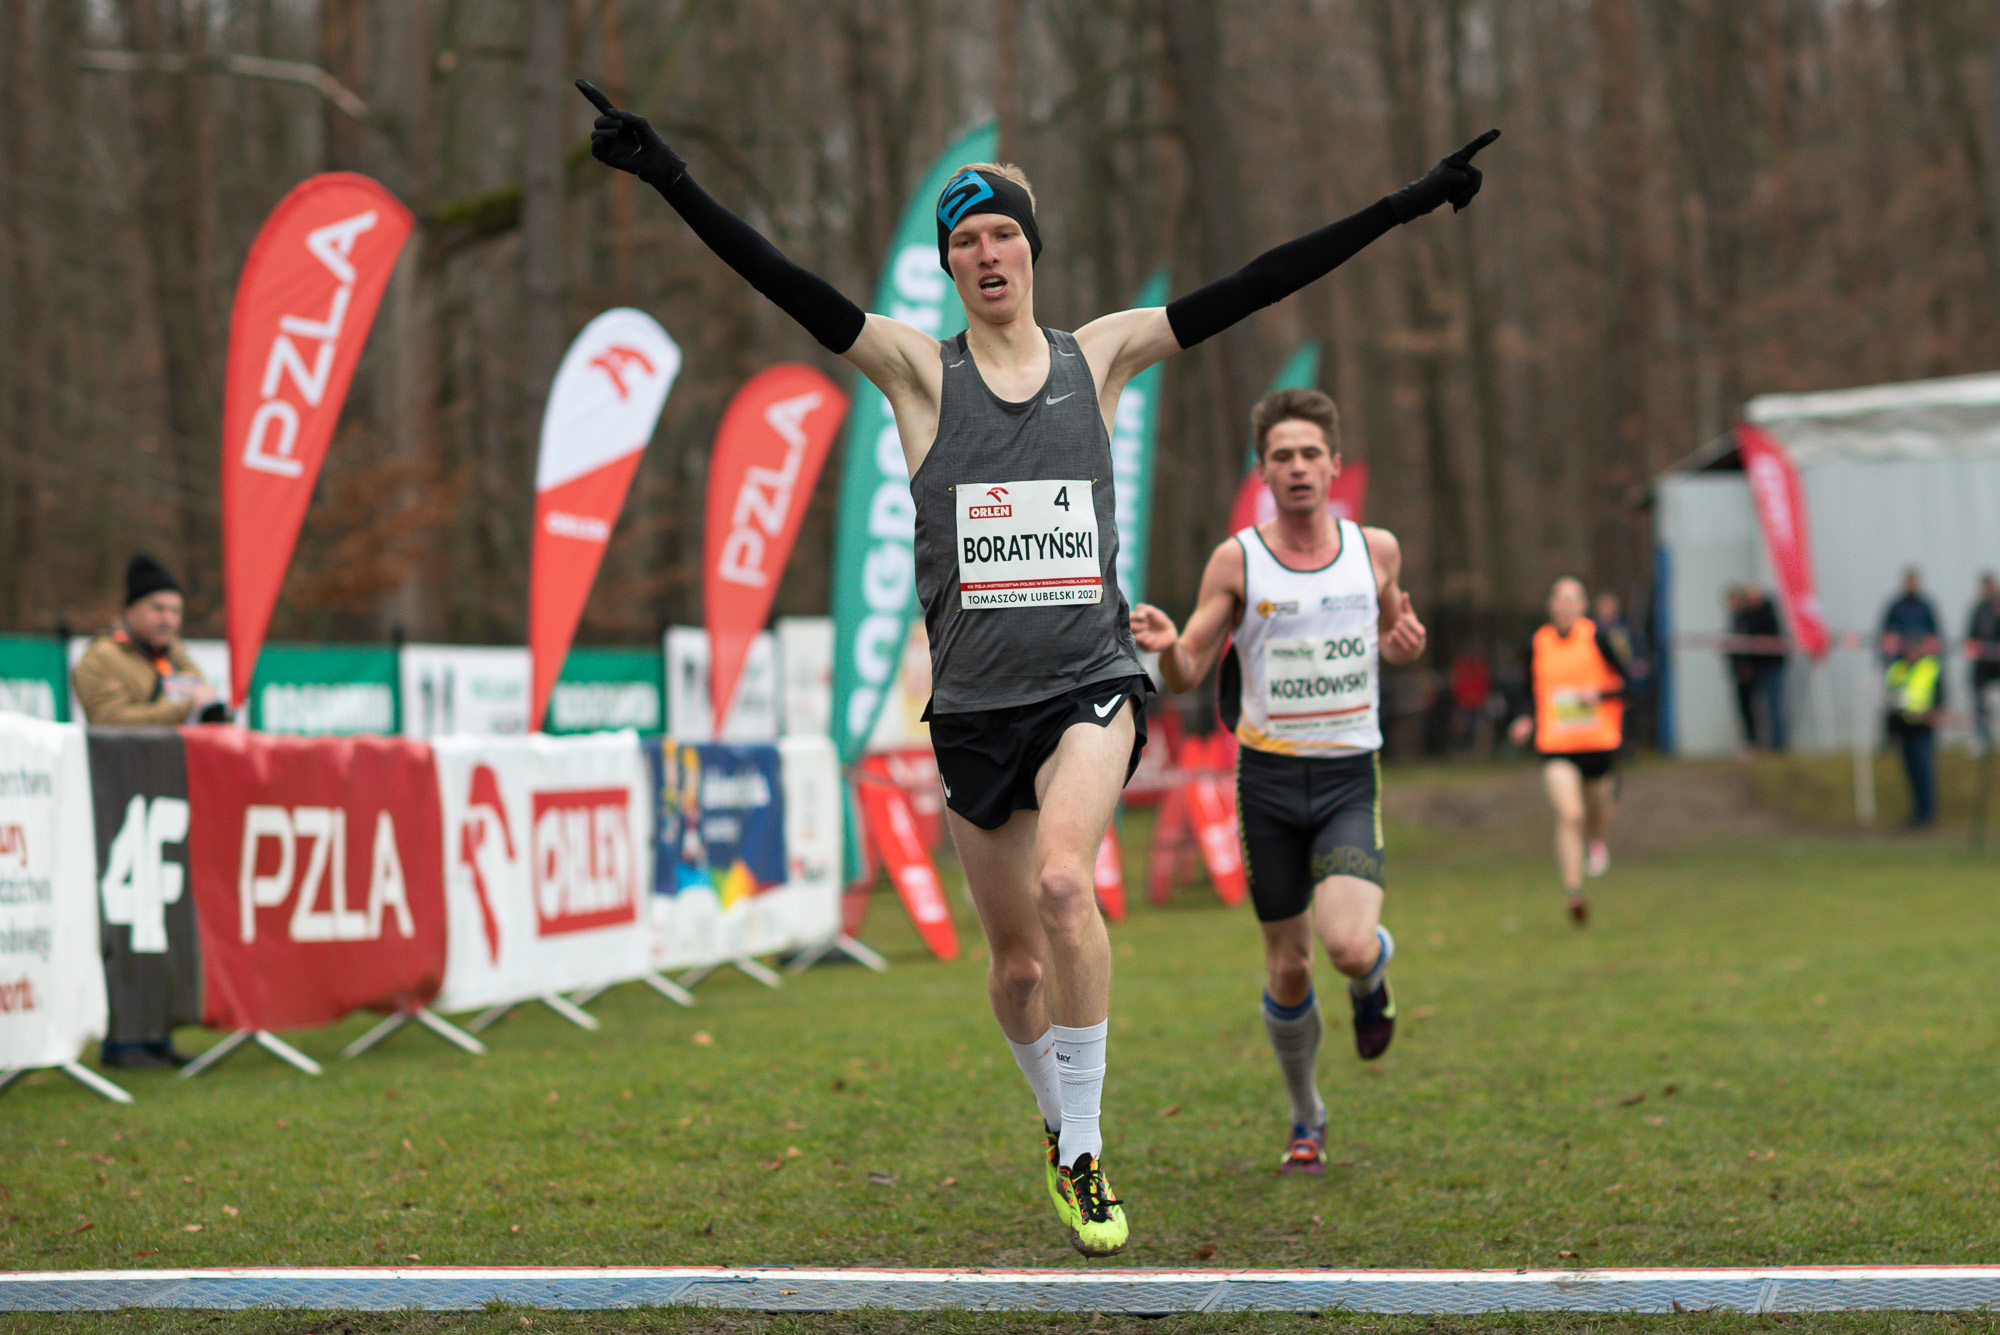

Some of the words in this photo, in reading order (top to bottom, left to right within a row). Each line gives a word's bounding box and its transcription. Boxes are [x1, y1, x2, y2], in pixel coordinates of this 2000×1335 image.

[242, 210, 377, 478] PZLA
[718, 391, 823, 587] PZLA
[1053, 485, 1070, 512] 4
[970, 506, 1010, 518] ORLEN
[963, 526, 1093, 564] BORATYŃSKI
[968, 591, 1027, 605] TOMASZÓW
[1031, 590, 1075, 601] LUBELSKI
[1078, 590, 1097, 599] 2021
[1324, 637, 1365, 660] 200
[1270, 671, 1367, 699] KOZŁOWSKI
[102, 794, 190, 952] 4F
[239, 804, 415, 944] PZLA
